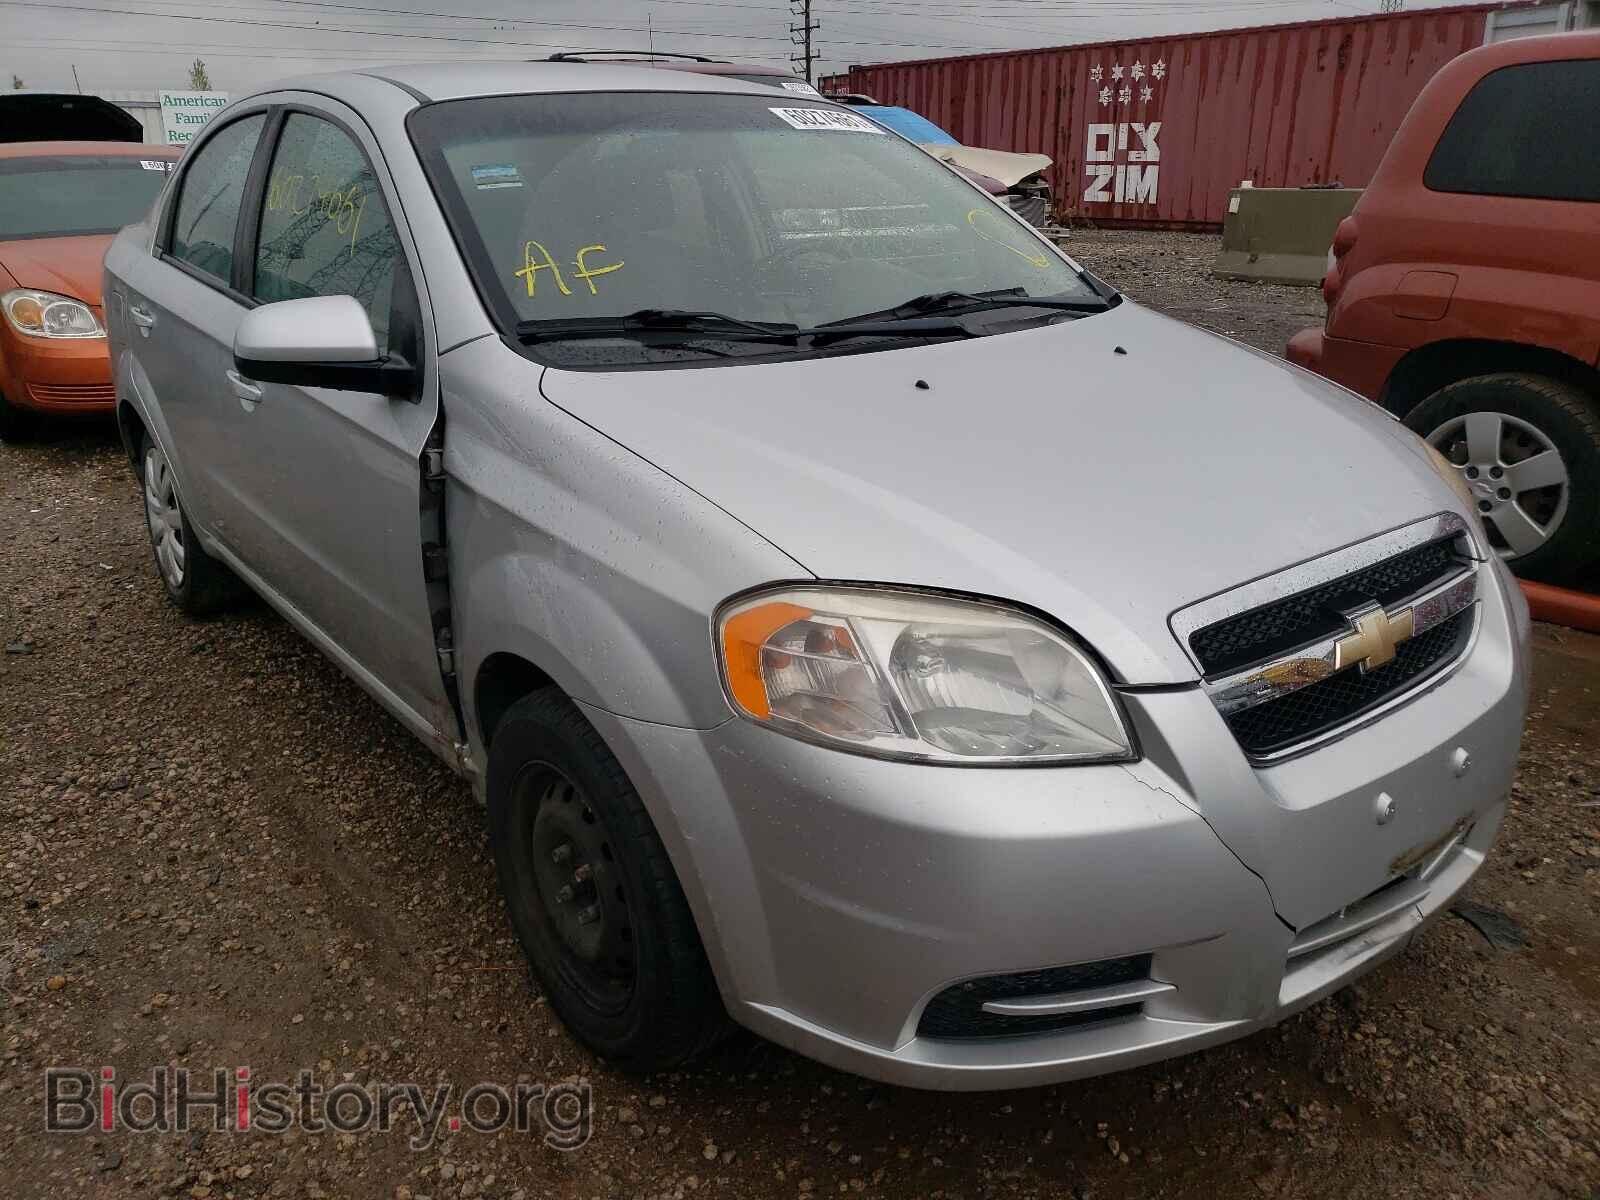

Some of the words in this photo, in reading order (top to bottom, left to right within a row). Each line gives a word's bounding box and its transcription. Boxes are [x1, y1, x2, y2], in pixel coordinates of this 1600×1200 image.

[162, 95, 226, 107] American
[175, 112, 210, 124] Fami
[1083, 164, 1160, 205] ZIM
